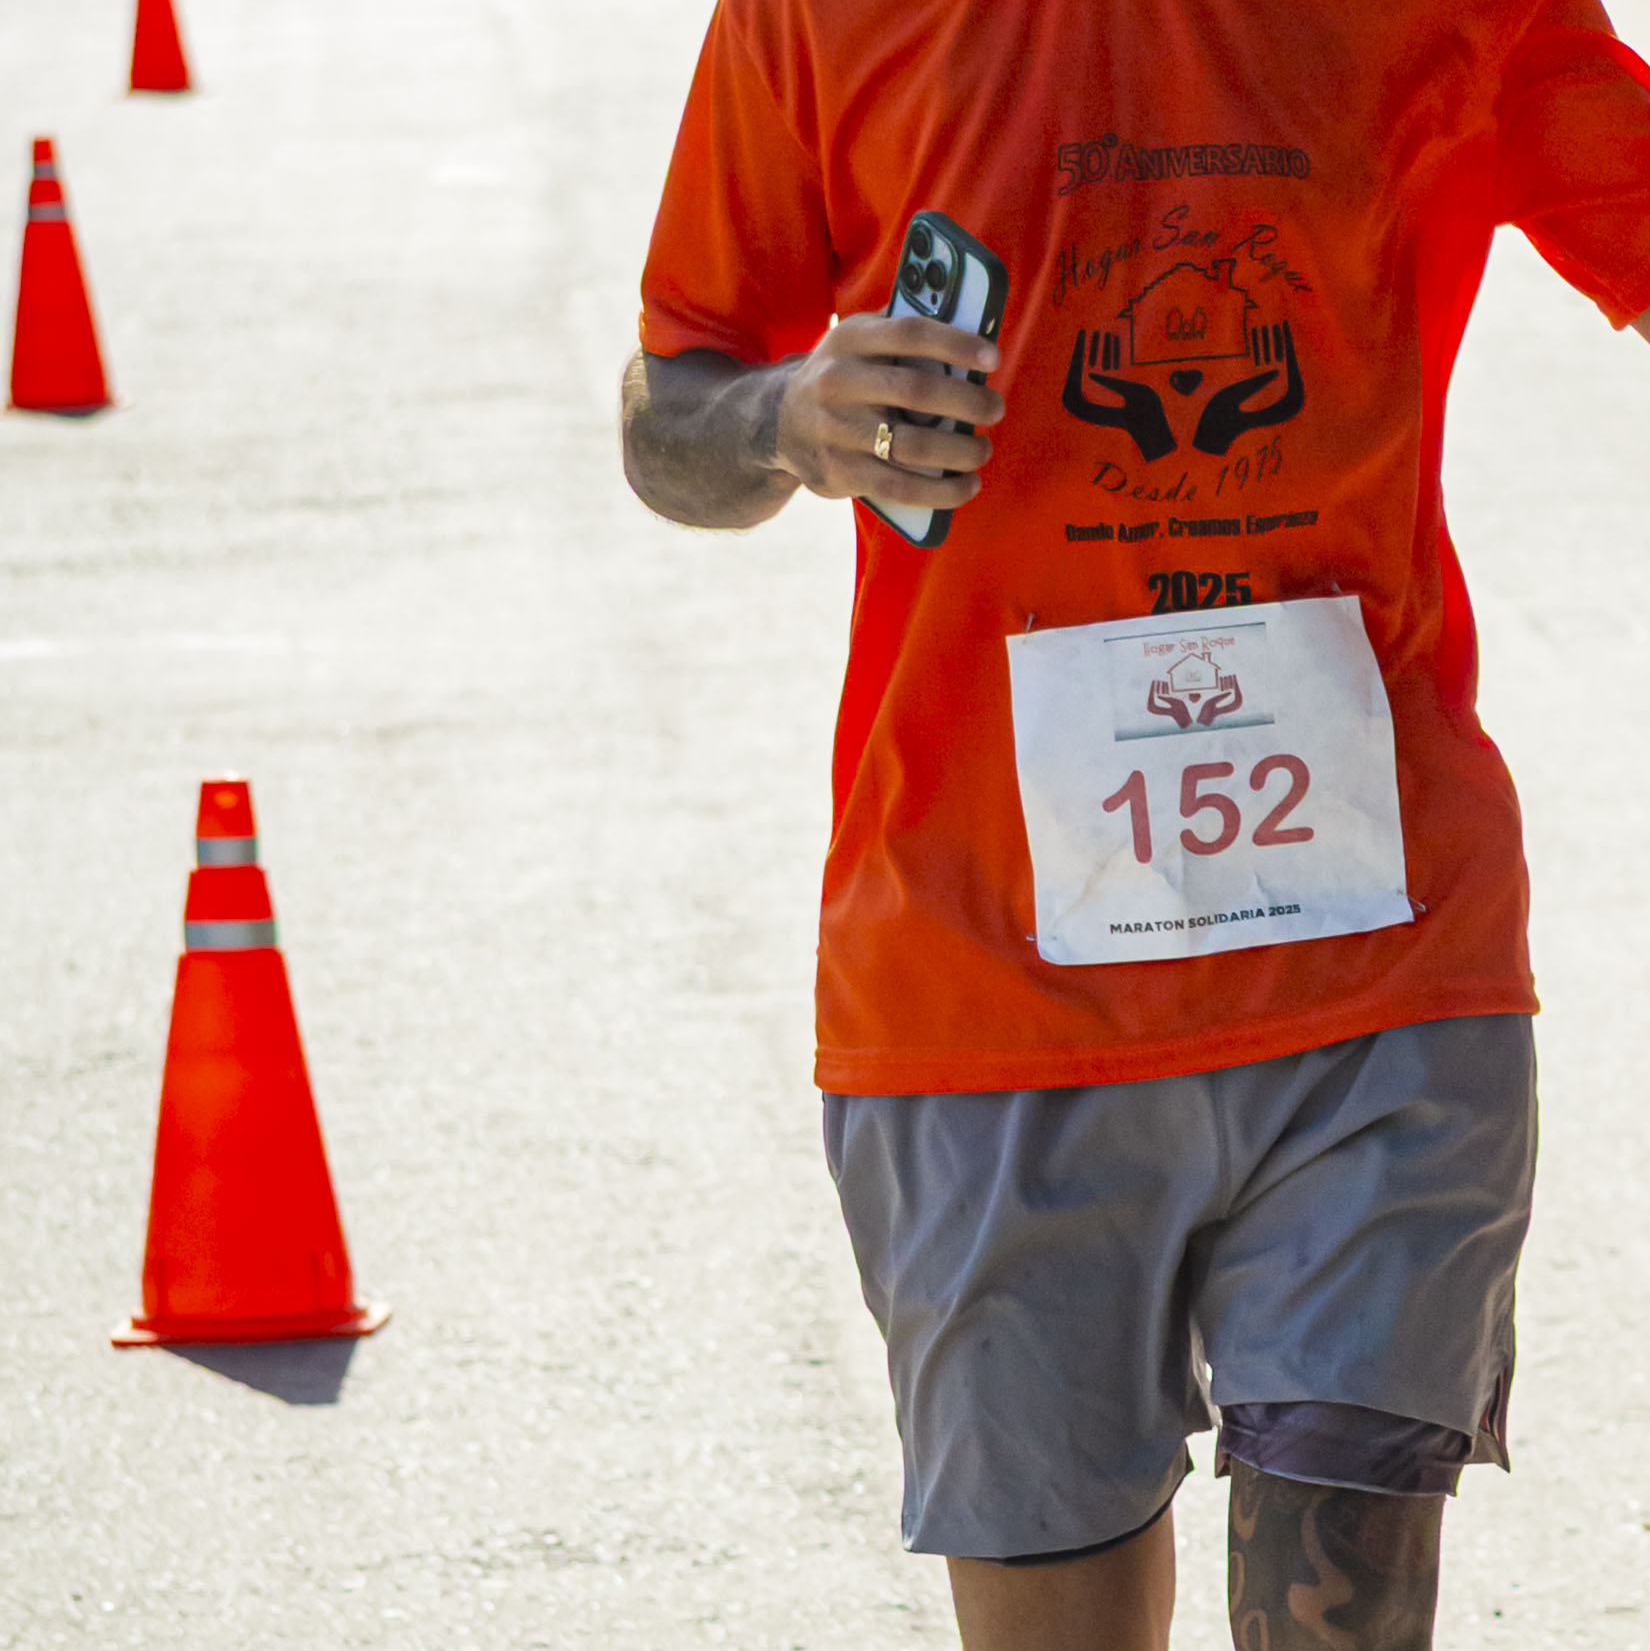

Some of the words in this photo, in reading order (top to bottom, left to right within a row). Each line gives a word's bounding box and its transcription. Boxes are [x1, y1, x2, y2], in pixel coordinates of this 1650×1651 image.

[1115, 143, 1310, 181] ANIVERSARIO
[1053, 238, 1141, 304] Hogar
[1152, 204, 1219, 250] San
[1093, 461, 1197, 501] Desde
[1216, 435, 1282, 496] 1975
[1065, 522, 1114, 541] Dando
[1168, 516, 1241, 537] Creamos
[1246, 510, 1319, 535] Esperanza
[1148, 570, 1251, 616] 2025
[1143, 642, 1175, 657] Hogar
[1179, 638, 1199, 653] San
[1200, 636, 1236, 651] Roque
[1102, 754, 1315, 864] 152
[1109, 919, 1185, 935] MARATON
[1188, 907, 1265, 929] SOLIDARIA
[1268, 903, 1301, 917] 2025
